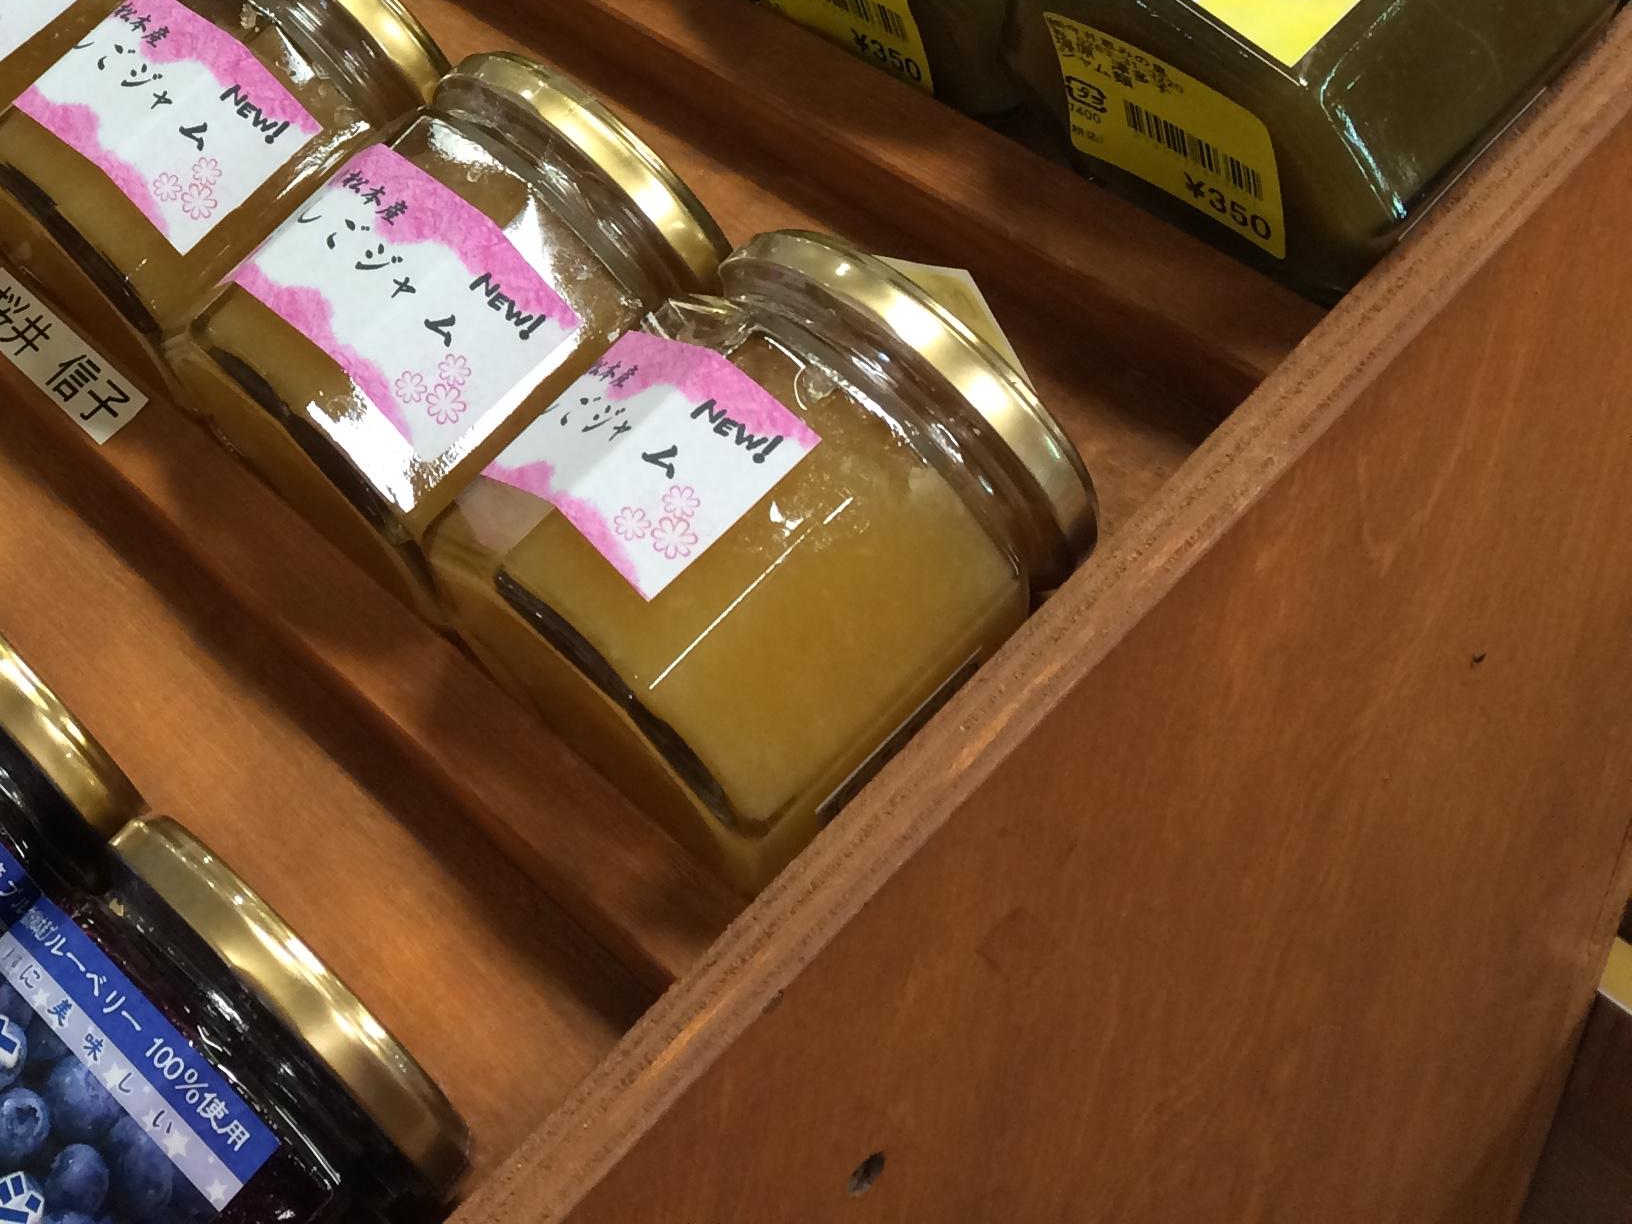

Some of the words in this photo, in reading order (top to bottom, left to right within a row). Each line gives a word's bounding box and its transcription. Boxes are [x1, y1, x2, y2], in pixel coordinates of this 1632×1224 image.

[114, 1, 173, 50] 松本産
[850, 26, 923, 83] ¥350
[341, 170, 411, 228] 松本産
[1182, 171, 1273, 241] ¥350
[45, 353, 132, 422] 信子
[143, 1034, 253, 1154] 100%使用
